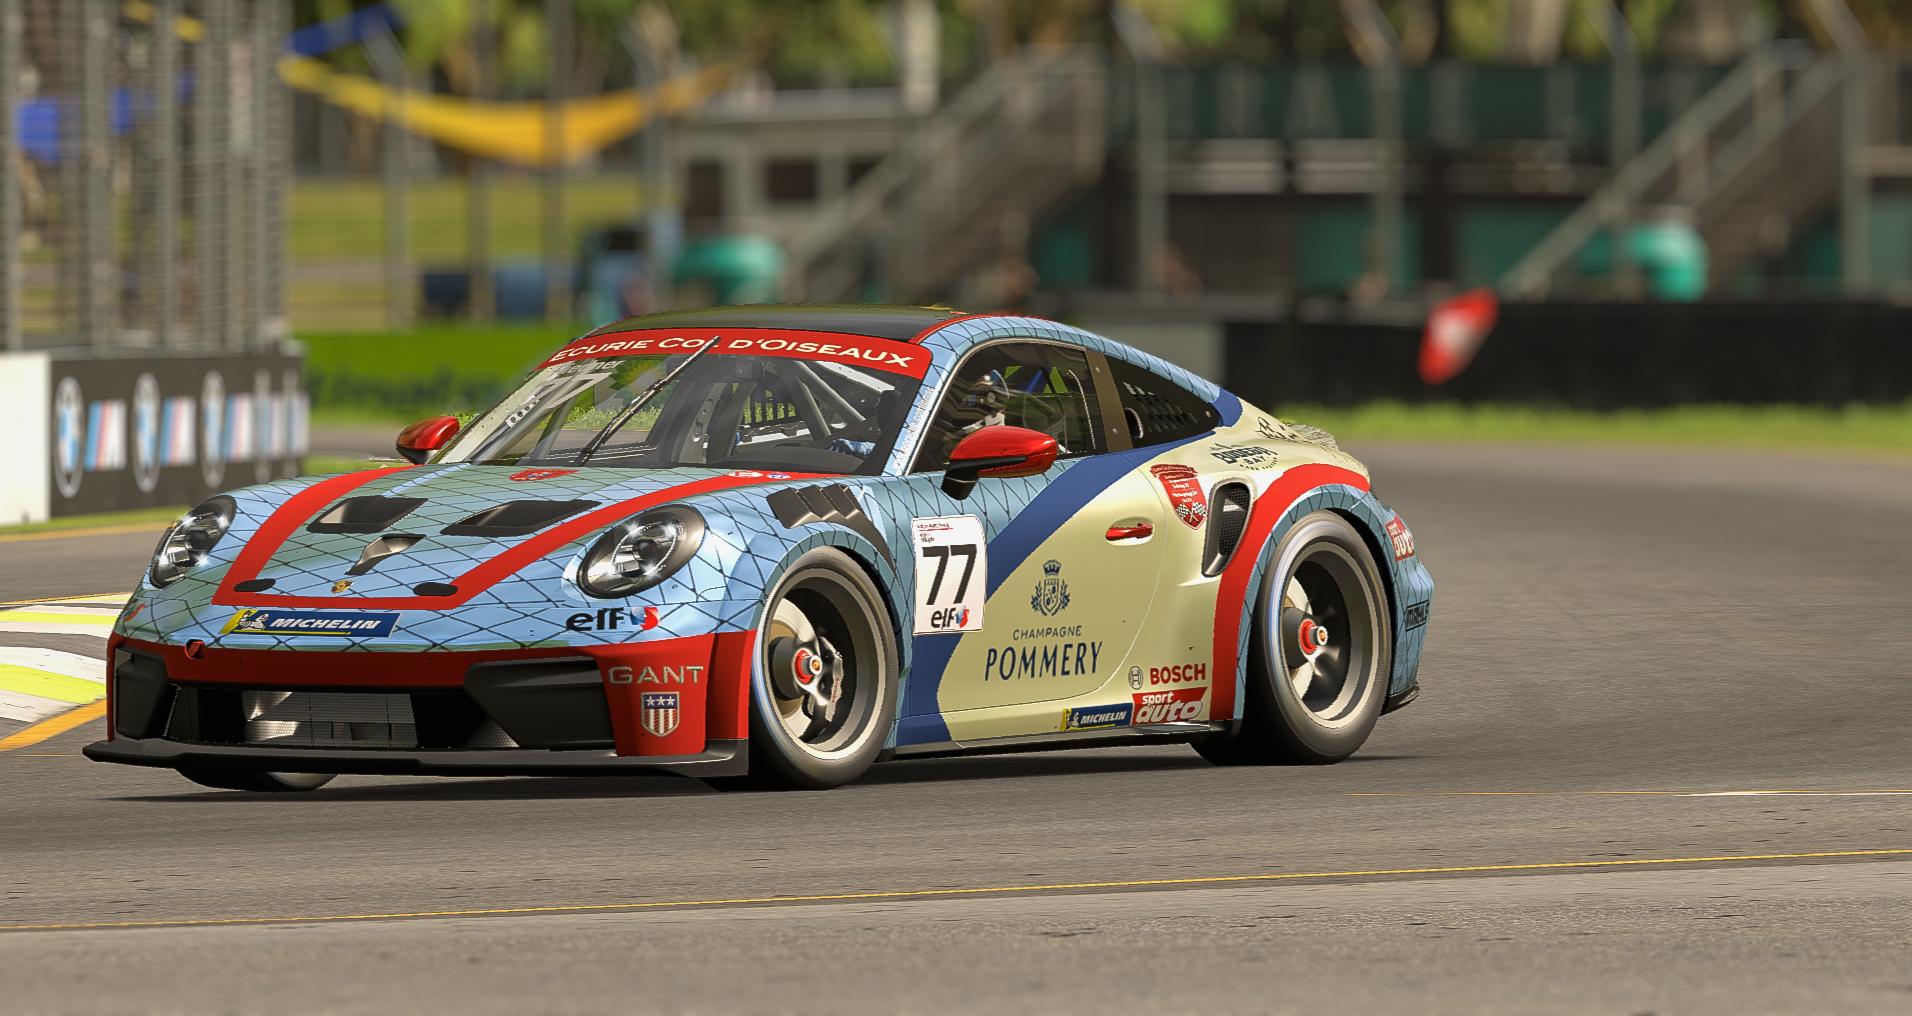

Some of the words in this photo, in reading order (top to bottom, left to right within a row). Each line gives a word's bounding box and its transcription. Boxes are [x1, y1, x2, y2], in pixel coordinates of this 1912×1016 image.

[549, 339, 654, 363] ECURIE
[921, 543, 977, 606] 77
[269, 617, 382, 630] MICHELIN
[565, 606, 625, 632] elf
[930, 606, 957, 629] elf
[1012, 624, 1082, 641] CHAMPAGNE
[984, 640, 1103, 681] POMMERY
[607, 665, 704, 685] GANT
[1149, 662, 1207, 686] BOSCH
[1142, 690, 1174, 706] sport
[1079, 709, 1127, 725] MICHELIN
[1136, 700, 1203, 724] auto
